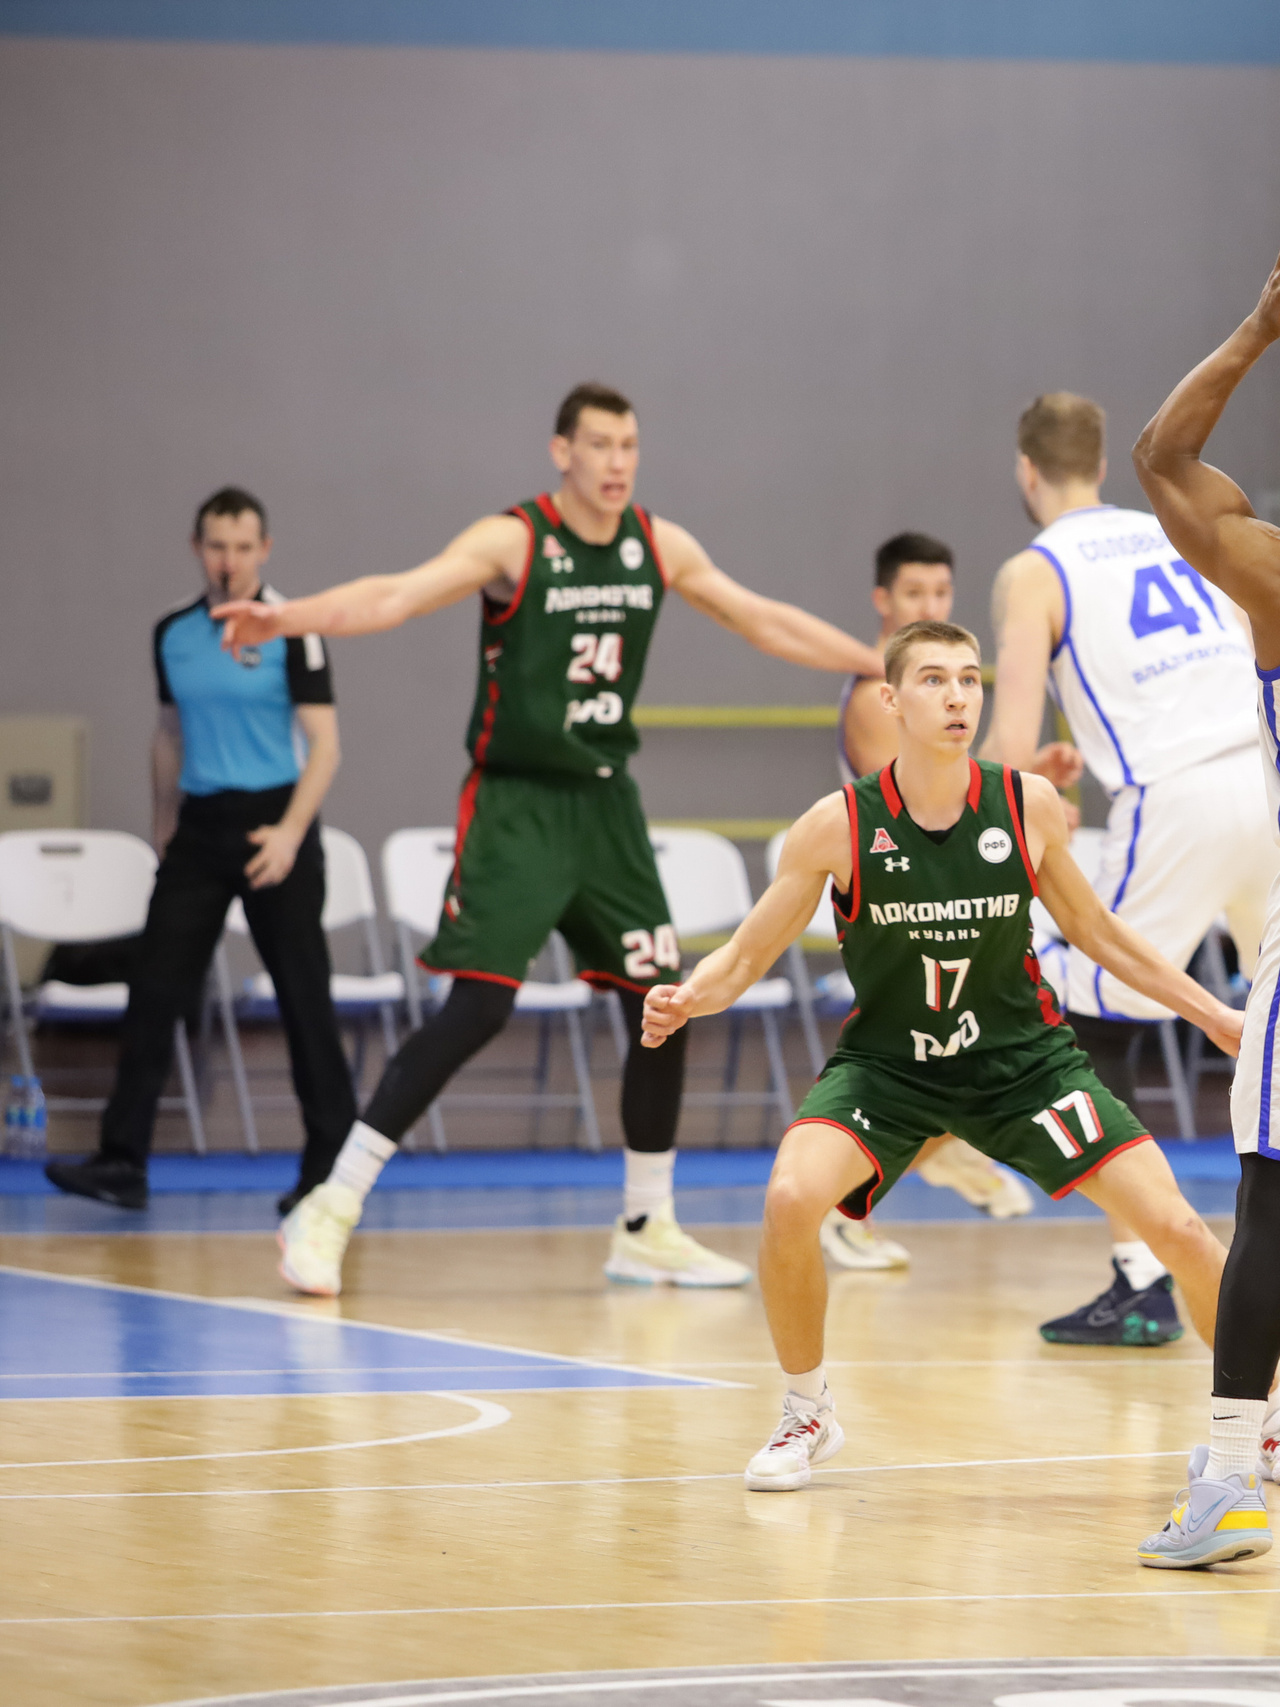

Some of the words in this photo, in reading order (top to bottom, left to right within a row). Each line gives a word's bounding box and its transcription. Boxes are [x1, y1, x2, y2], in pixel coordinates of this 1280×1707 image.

[1129, 558, 1226, 640] 41
[566, 633, 623, 683] 24
[984, 839, 1006, 851] РФБ
[868, 894, 1020, 925] ЛОКОМОТИВ
[909, 928, 980, 942] КУБАНЬ
[621, 923, 680, 978] 24
[921, 954, 971, 1012] 17
[1031, 1090, 1105, 1159] 17
